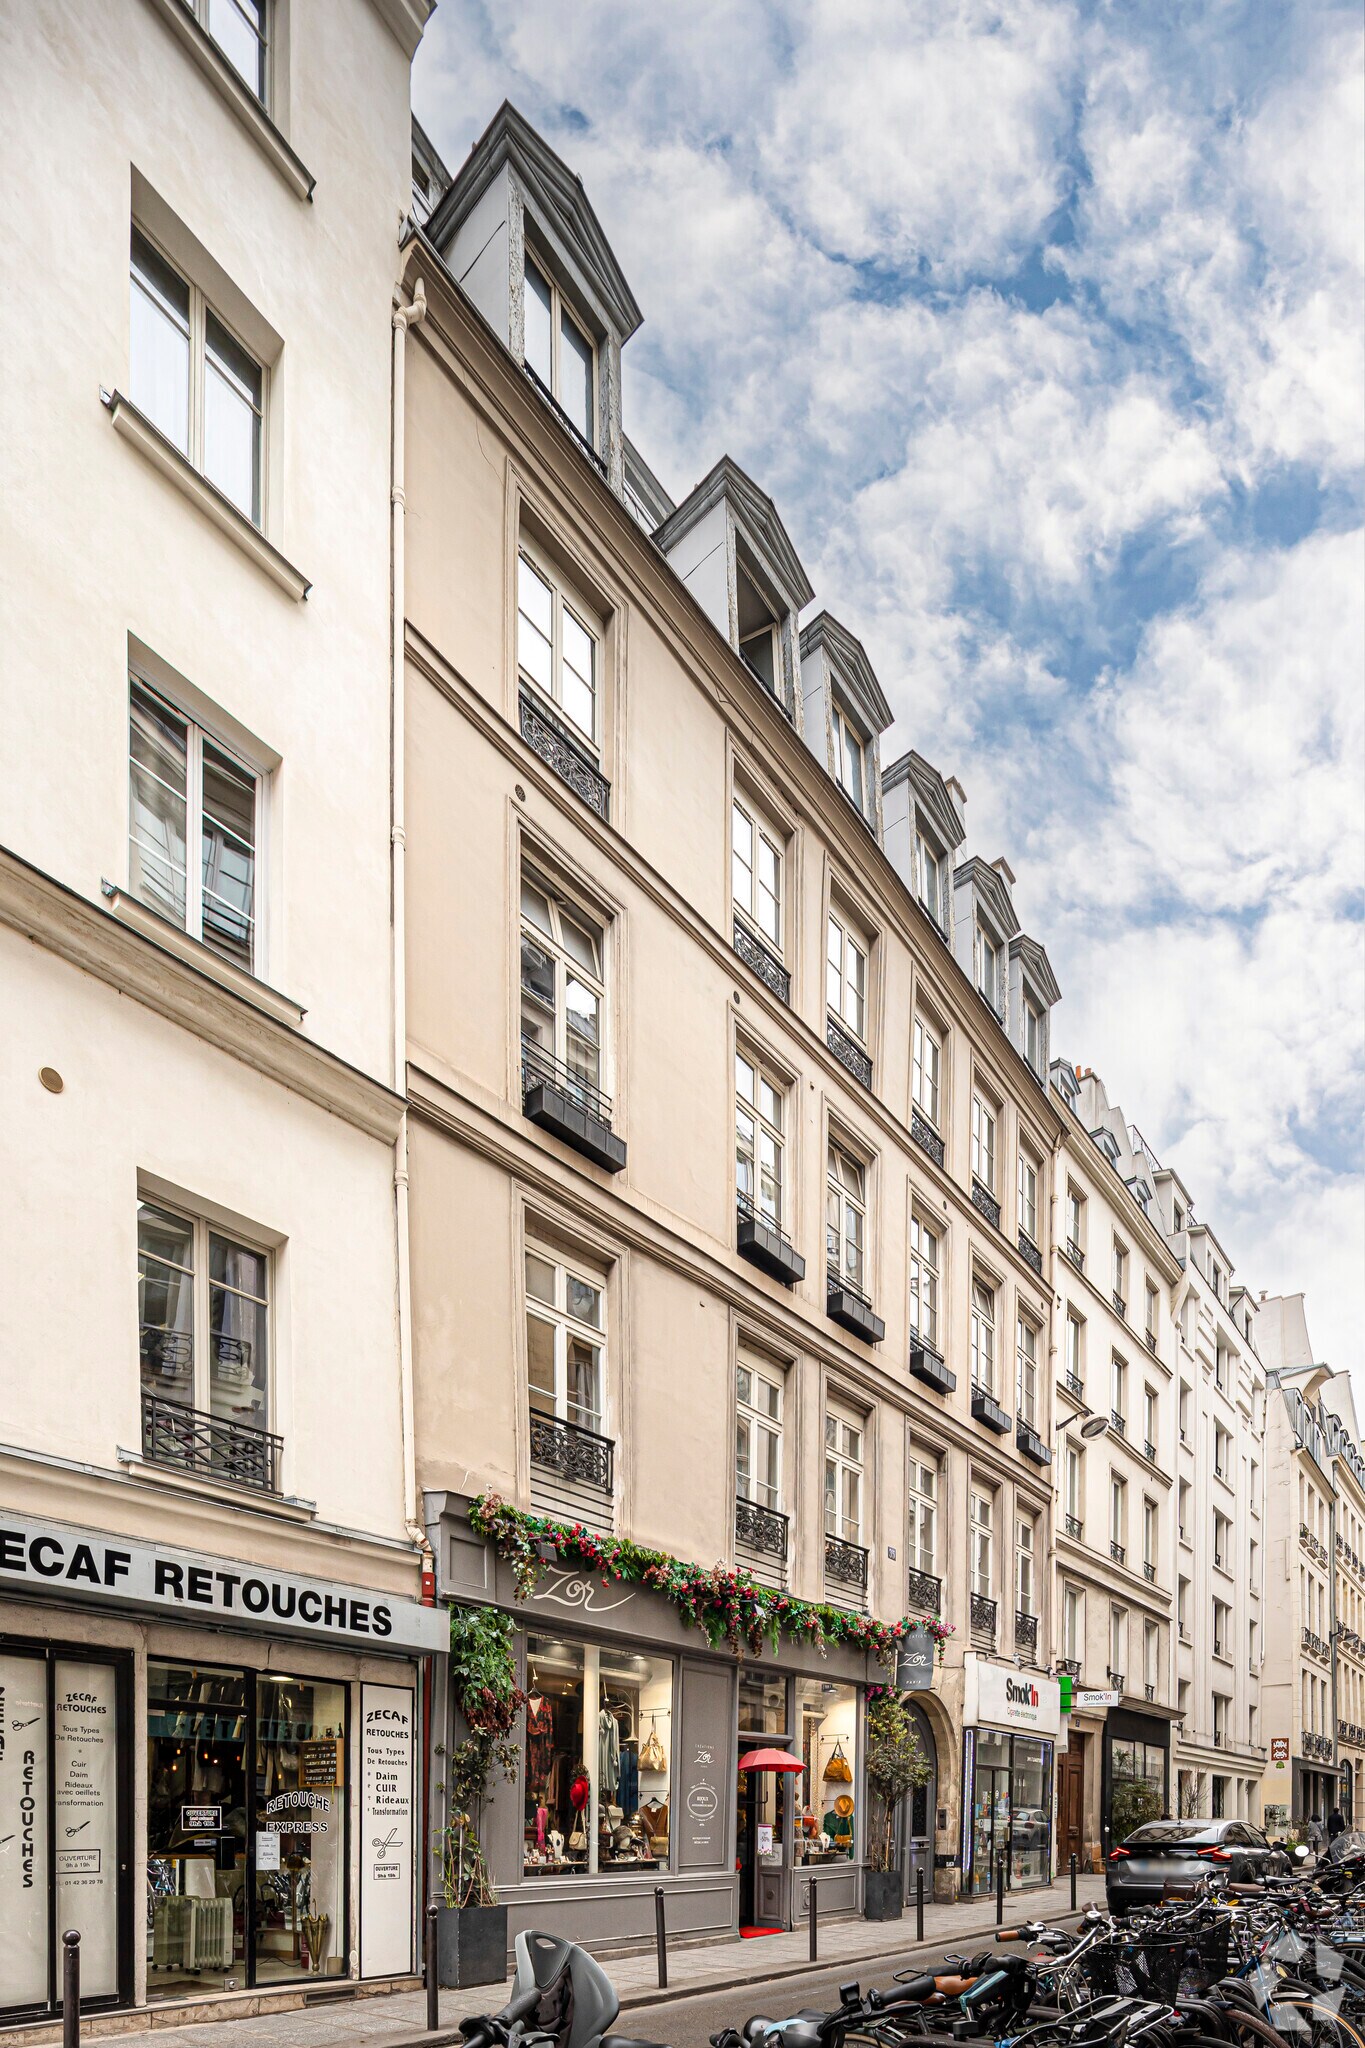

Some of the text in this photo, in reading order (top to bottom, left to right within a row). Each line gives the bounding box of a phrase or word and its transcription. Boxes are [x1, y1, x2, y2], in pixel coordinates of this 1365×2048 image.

[0, 1529, 393, 1636] ECAF RETOUCHES
[533, 1564, 636, 1612] Zor
[898, 1651, 933, 1668] Zor
[66, 1692, 98, 1704] ZECAF
[56, 1703, 107, 1714] RETOUCHES
[366, 1709, 409, 1725] ZECAF
[62, 1725, 100, 1734] Tous Types
[366, 1728, 409, 1739] RETOUCHES
[67, 1734, 104, 1743] Retouches
[367, 1747, 405, 1757] Tous Types
[71, 1760, 87, 1768] Cuir
[367, 1757, 408, 1766] De Retouches
[69, 1770, 88, 1778] Daim
[376, 1771, 398, 1781] Daim
[64, 1781, 93, 1789] Rideaux
[375, 1783, 397, 1793] CUIR
[75, 1789, 101, 1797] oeillets
[55, 1799, 104, 1807] ansformation
[266, 1791, 331, 1815] RETOUCHE
[376, 1795, 409, 1804] Rideaux
[186, 1809, 218, 1817] OUVERTURE
[372, 1807, 408, 1816] Transformation
[20, 1750, 35, 1888] RETOUCHES
[265, 1821, 329, 1834] EXPRESS
[59, 1854, 97, 1862] OUVERTURE
